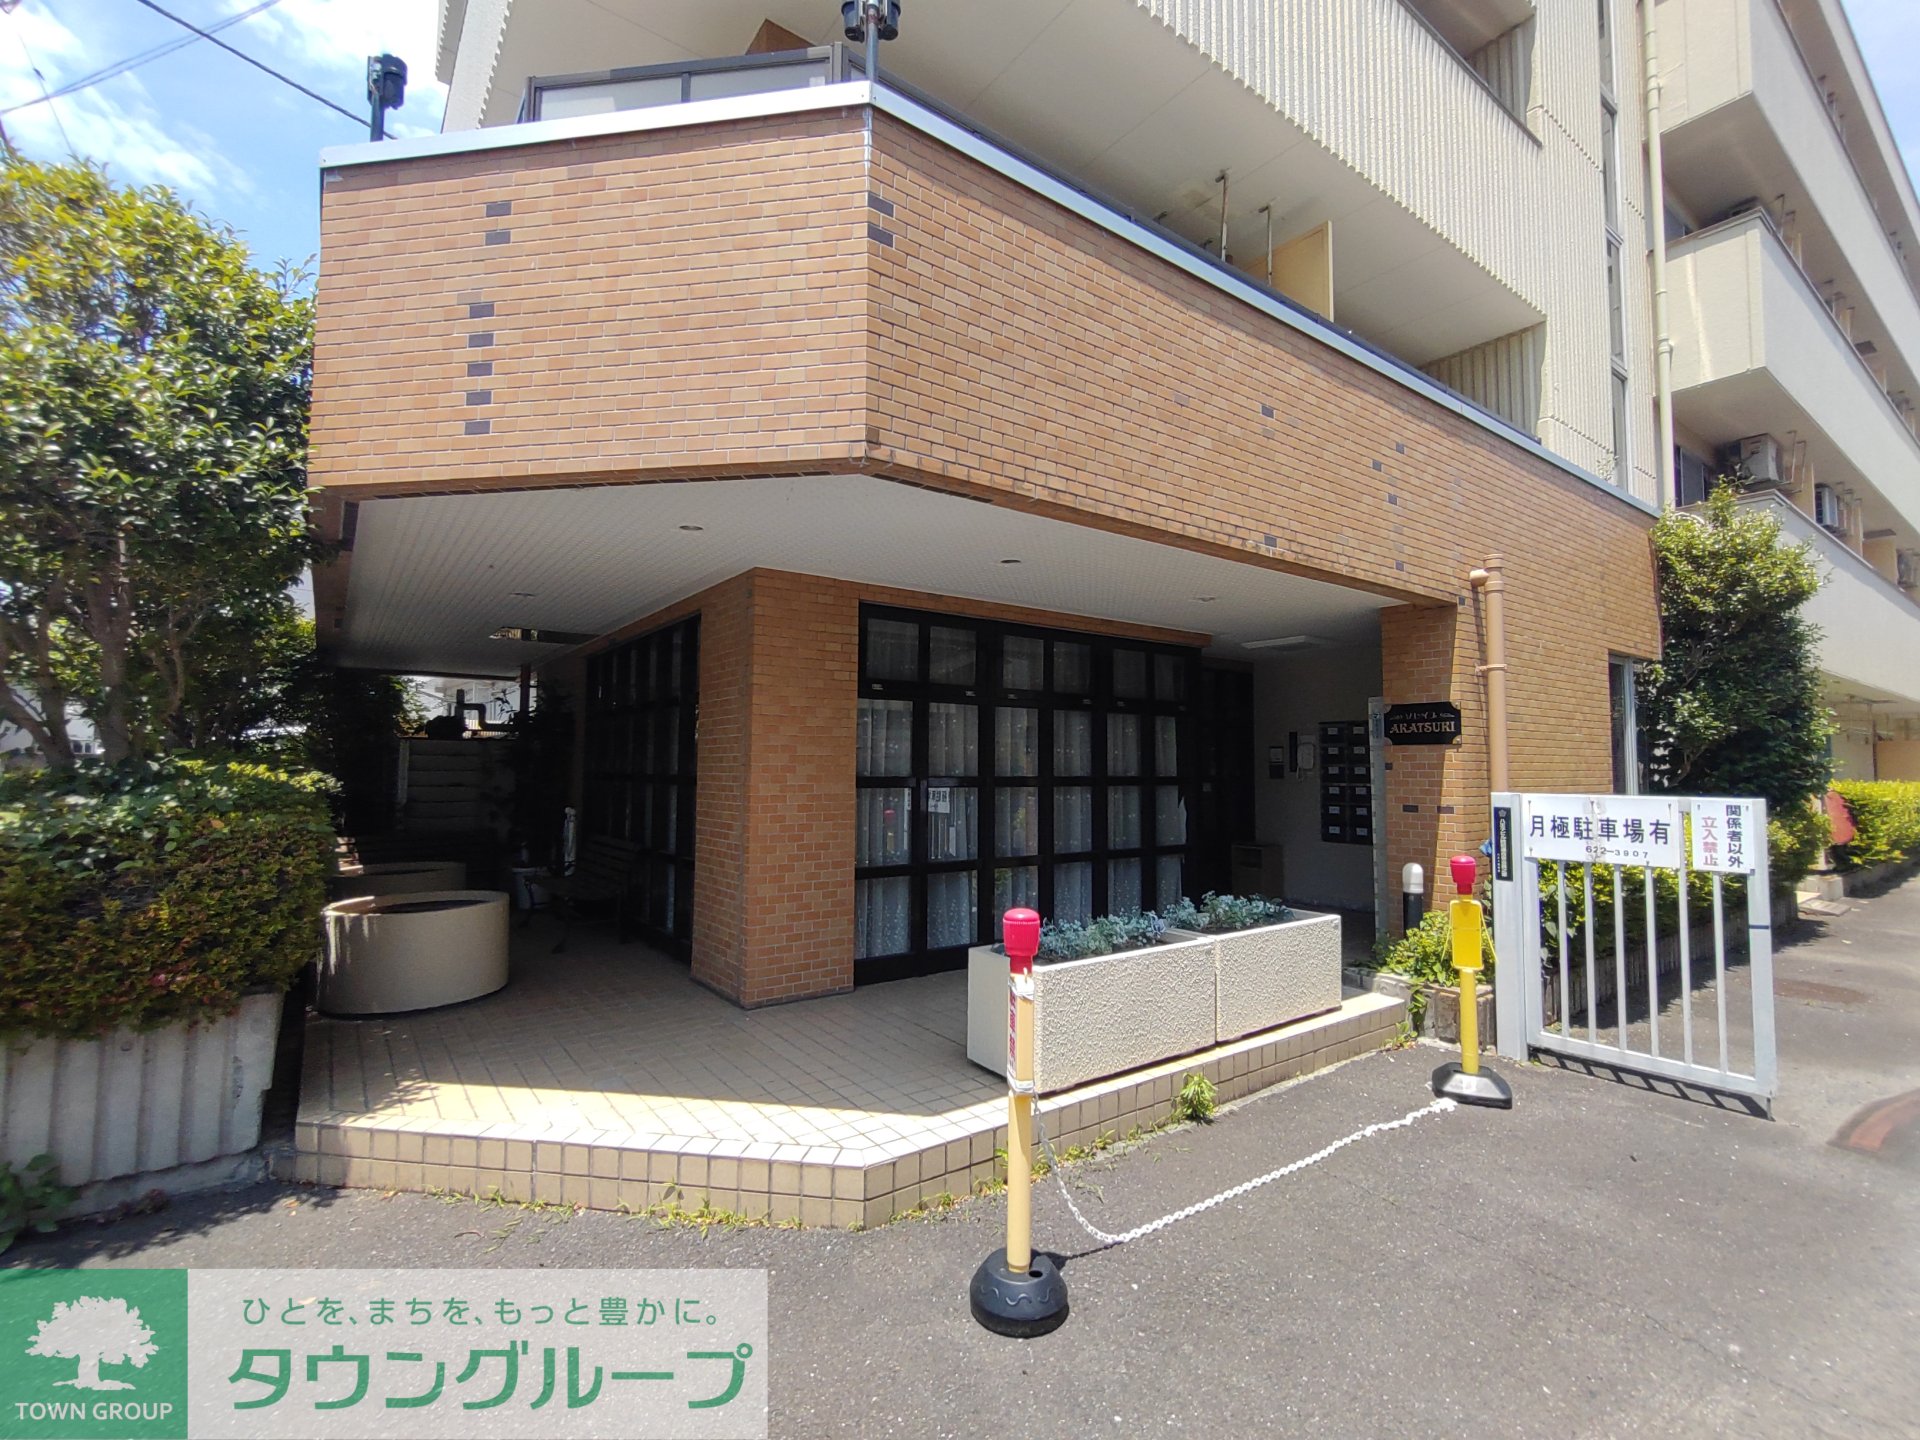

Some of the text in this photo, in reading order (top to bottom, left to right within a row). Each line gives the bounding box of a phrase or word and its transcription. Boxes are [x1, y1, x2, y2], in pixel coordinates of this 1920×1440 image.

[1530, 814, 1671, 845] 月極駐車場有
[1701, 816, 1719, 867] 立入禁止
[1726, 804, 1744, 868] 関係者以外
